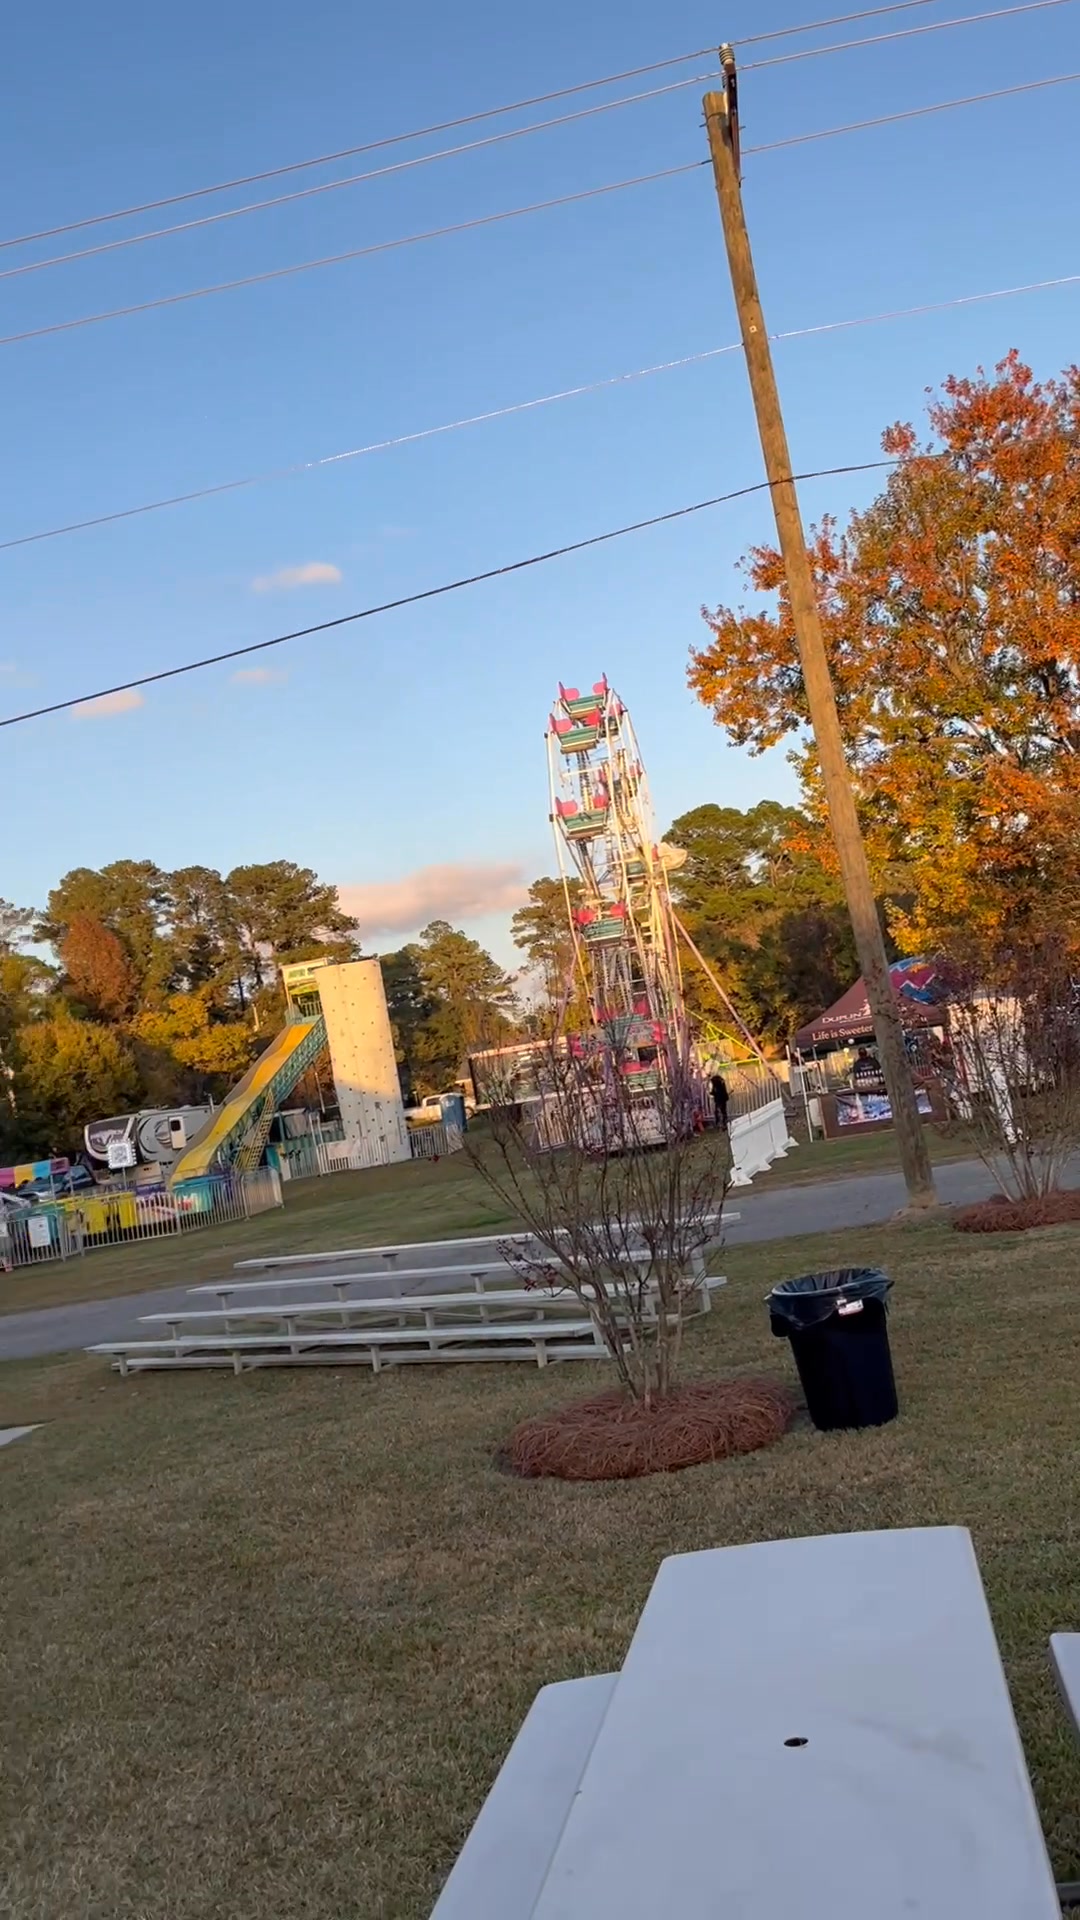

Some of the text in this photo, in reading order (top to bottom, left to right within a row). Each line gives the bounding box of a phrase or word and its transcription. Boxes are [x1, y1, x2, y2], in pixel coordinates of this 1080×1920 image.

[812, 1025, 873, 1041] Life is Sweeter
